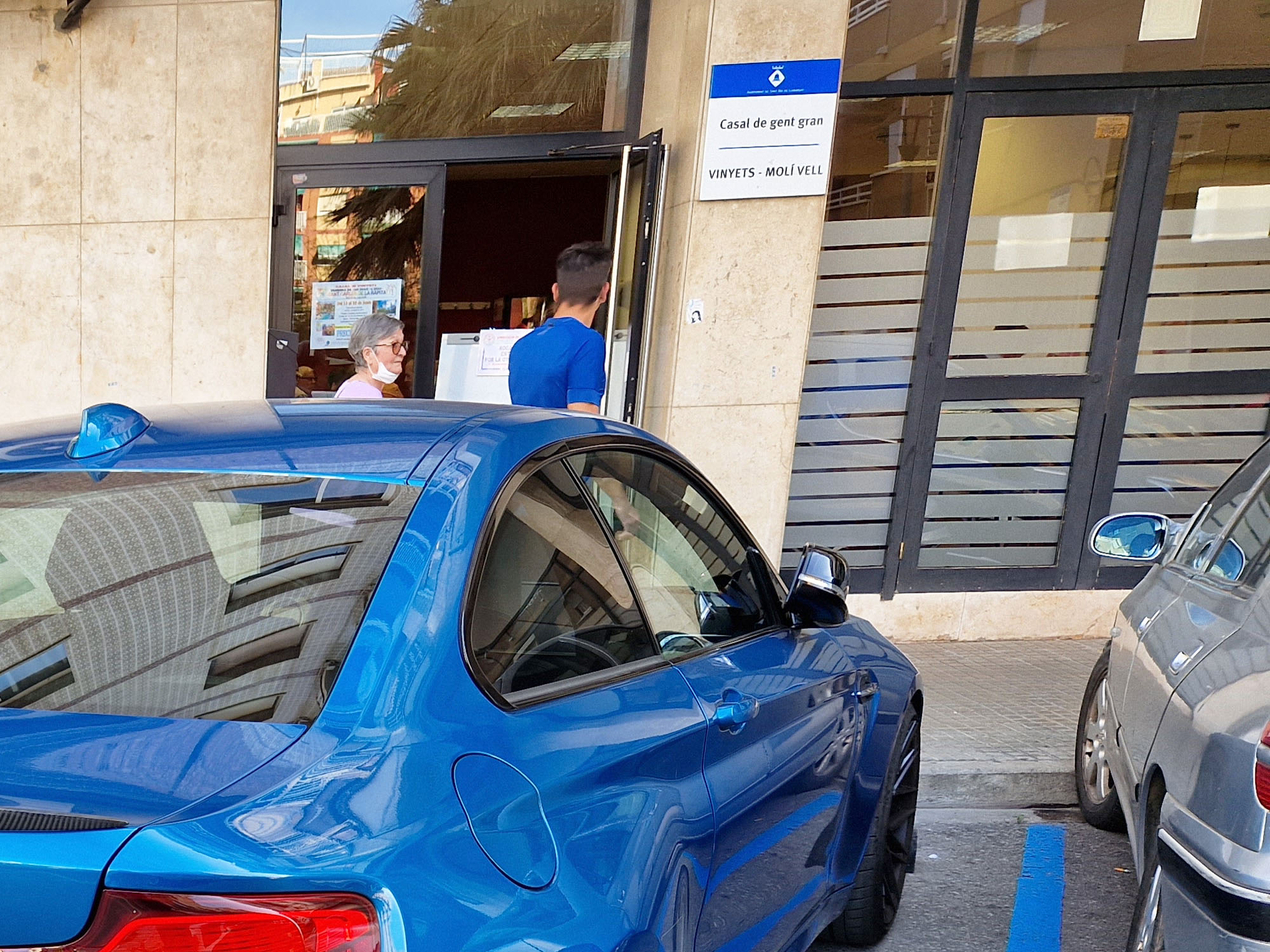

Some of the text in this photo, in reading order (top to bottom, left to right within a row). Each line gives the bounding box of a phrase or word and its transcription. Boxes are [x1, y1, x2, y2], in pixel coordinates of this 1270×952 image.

[720, 116, 823, 130] Casal de gent gran
[709, 167, 755, 179] VINYETS
[765, 163, 795, 177] MOLÍ
[797, 165, 823, 176] VELL
